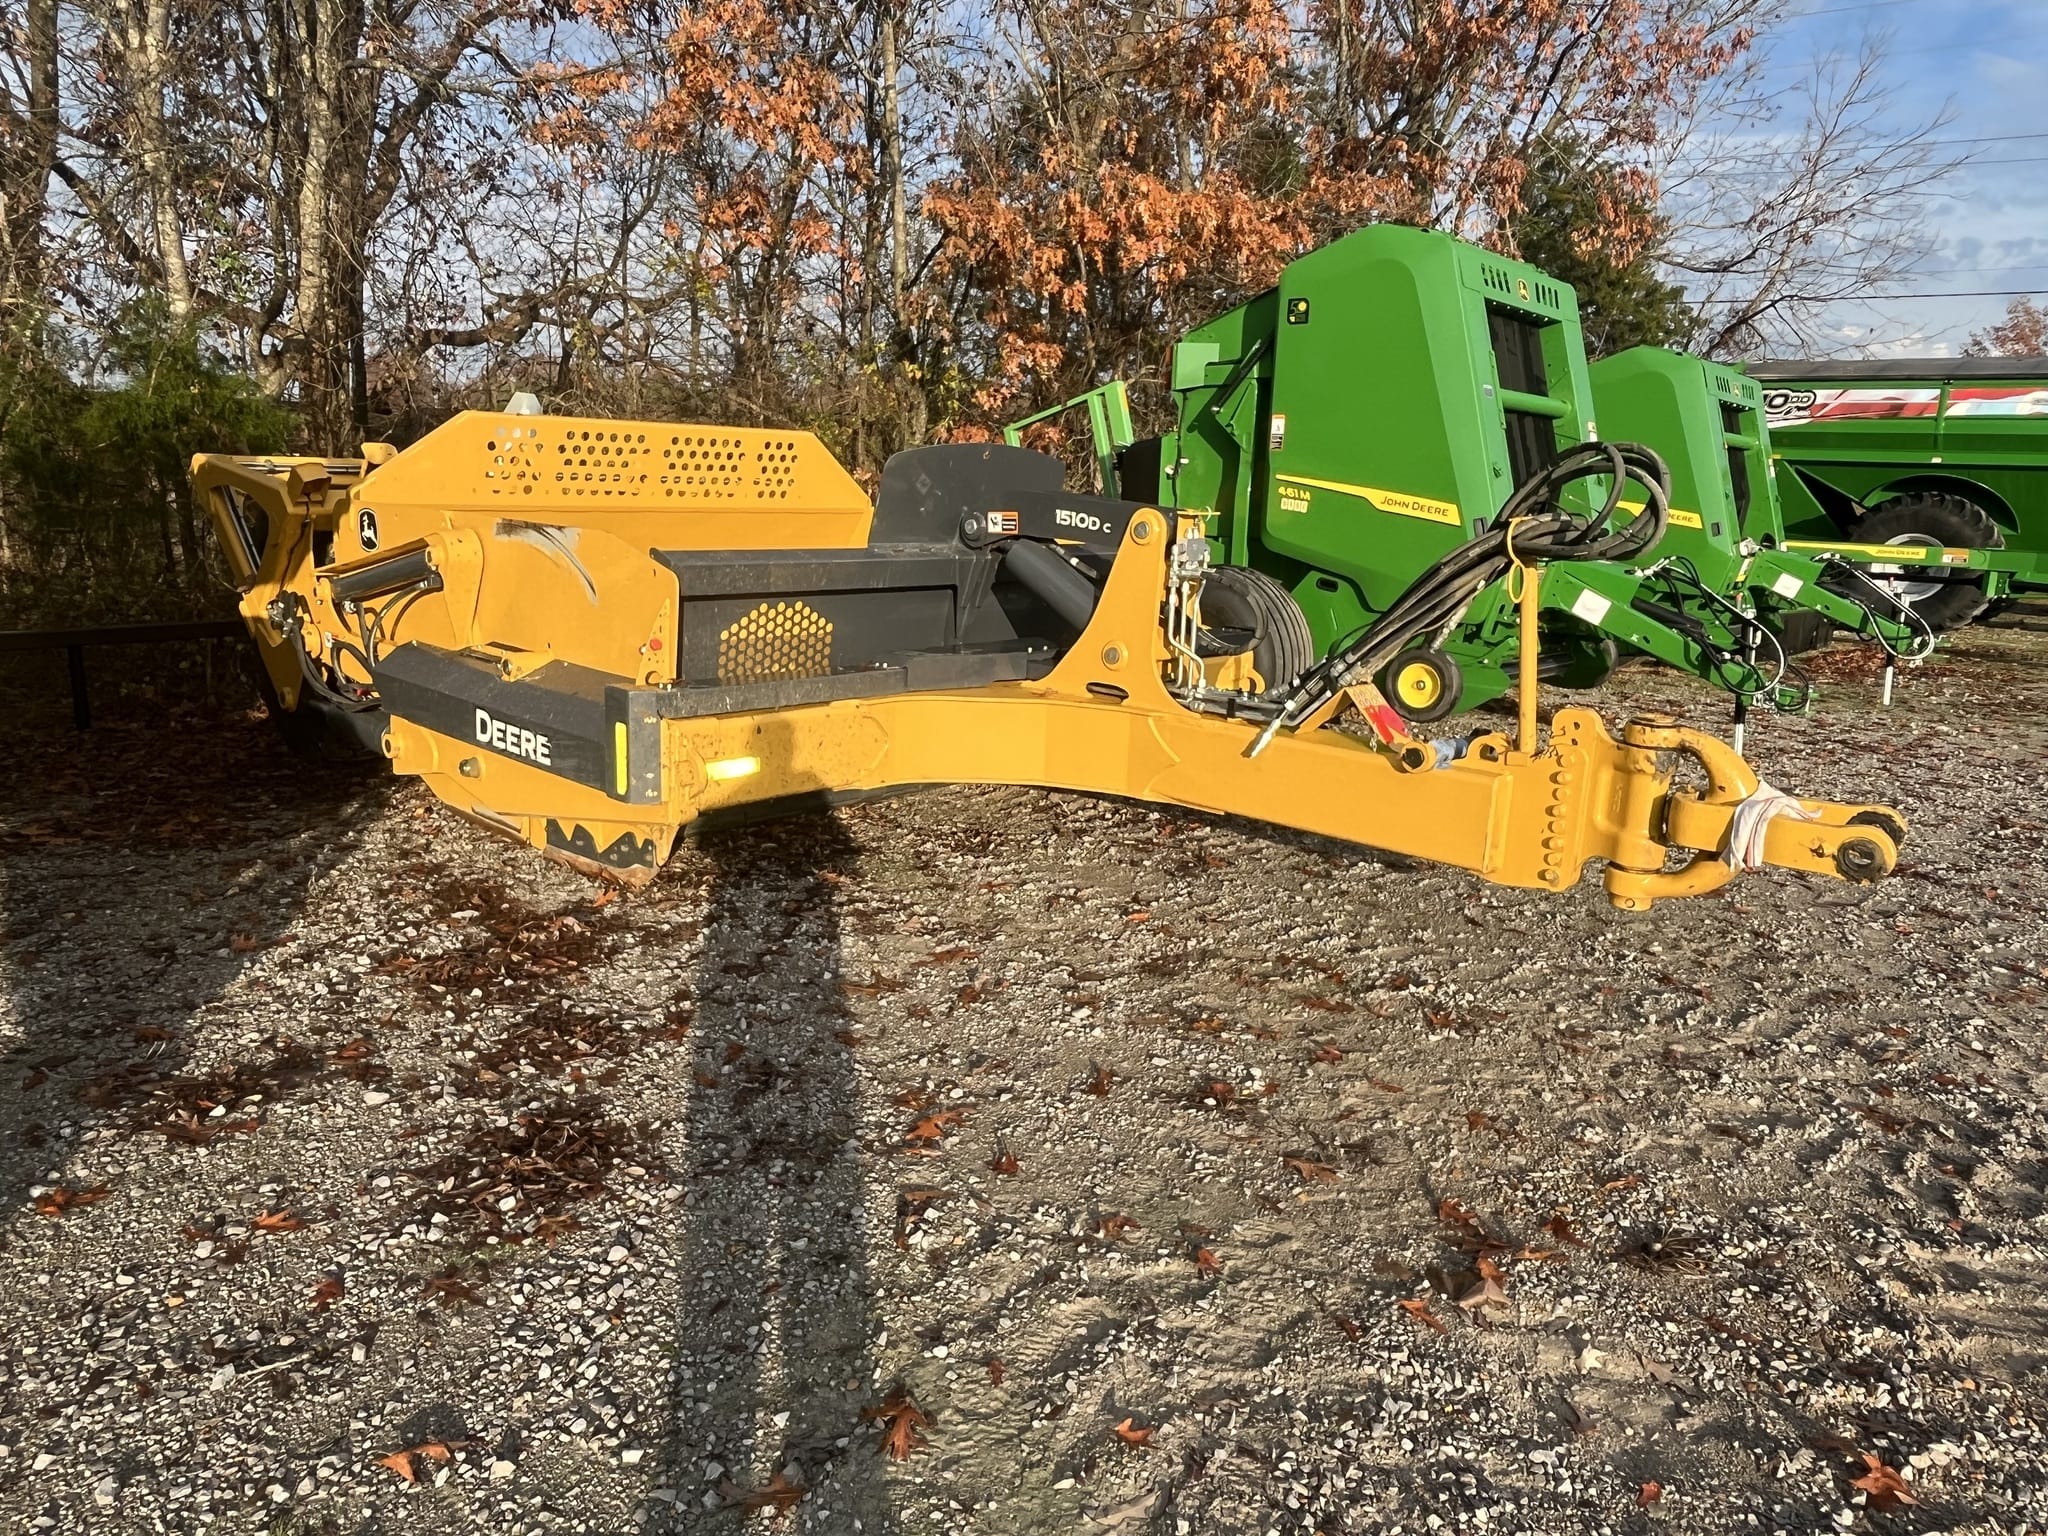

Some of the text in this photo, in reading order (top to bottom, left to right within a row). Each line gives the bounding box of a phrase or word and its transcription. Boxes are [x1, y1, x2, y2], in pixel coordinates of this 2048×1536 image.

[1380, 496, 1449, 517] JOHN DEERE
[1055, 509, 1100, 531] 1510D
[475, 708, 552, 767] DEERE
